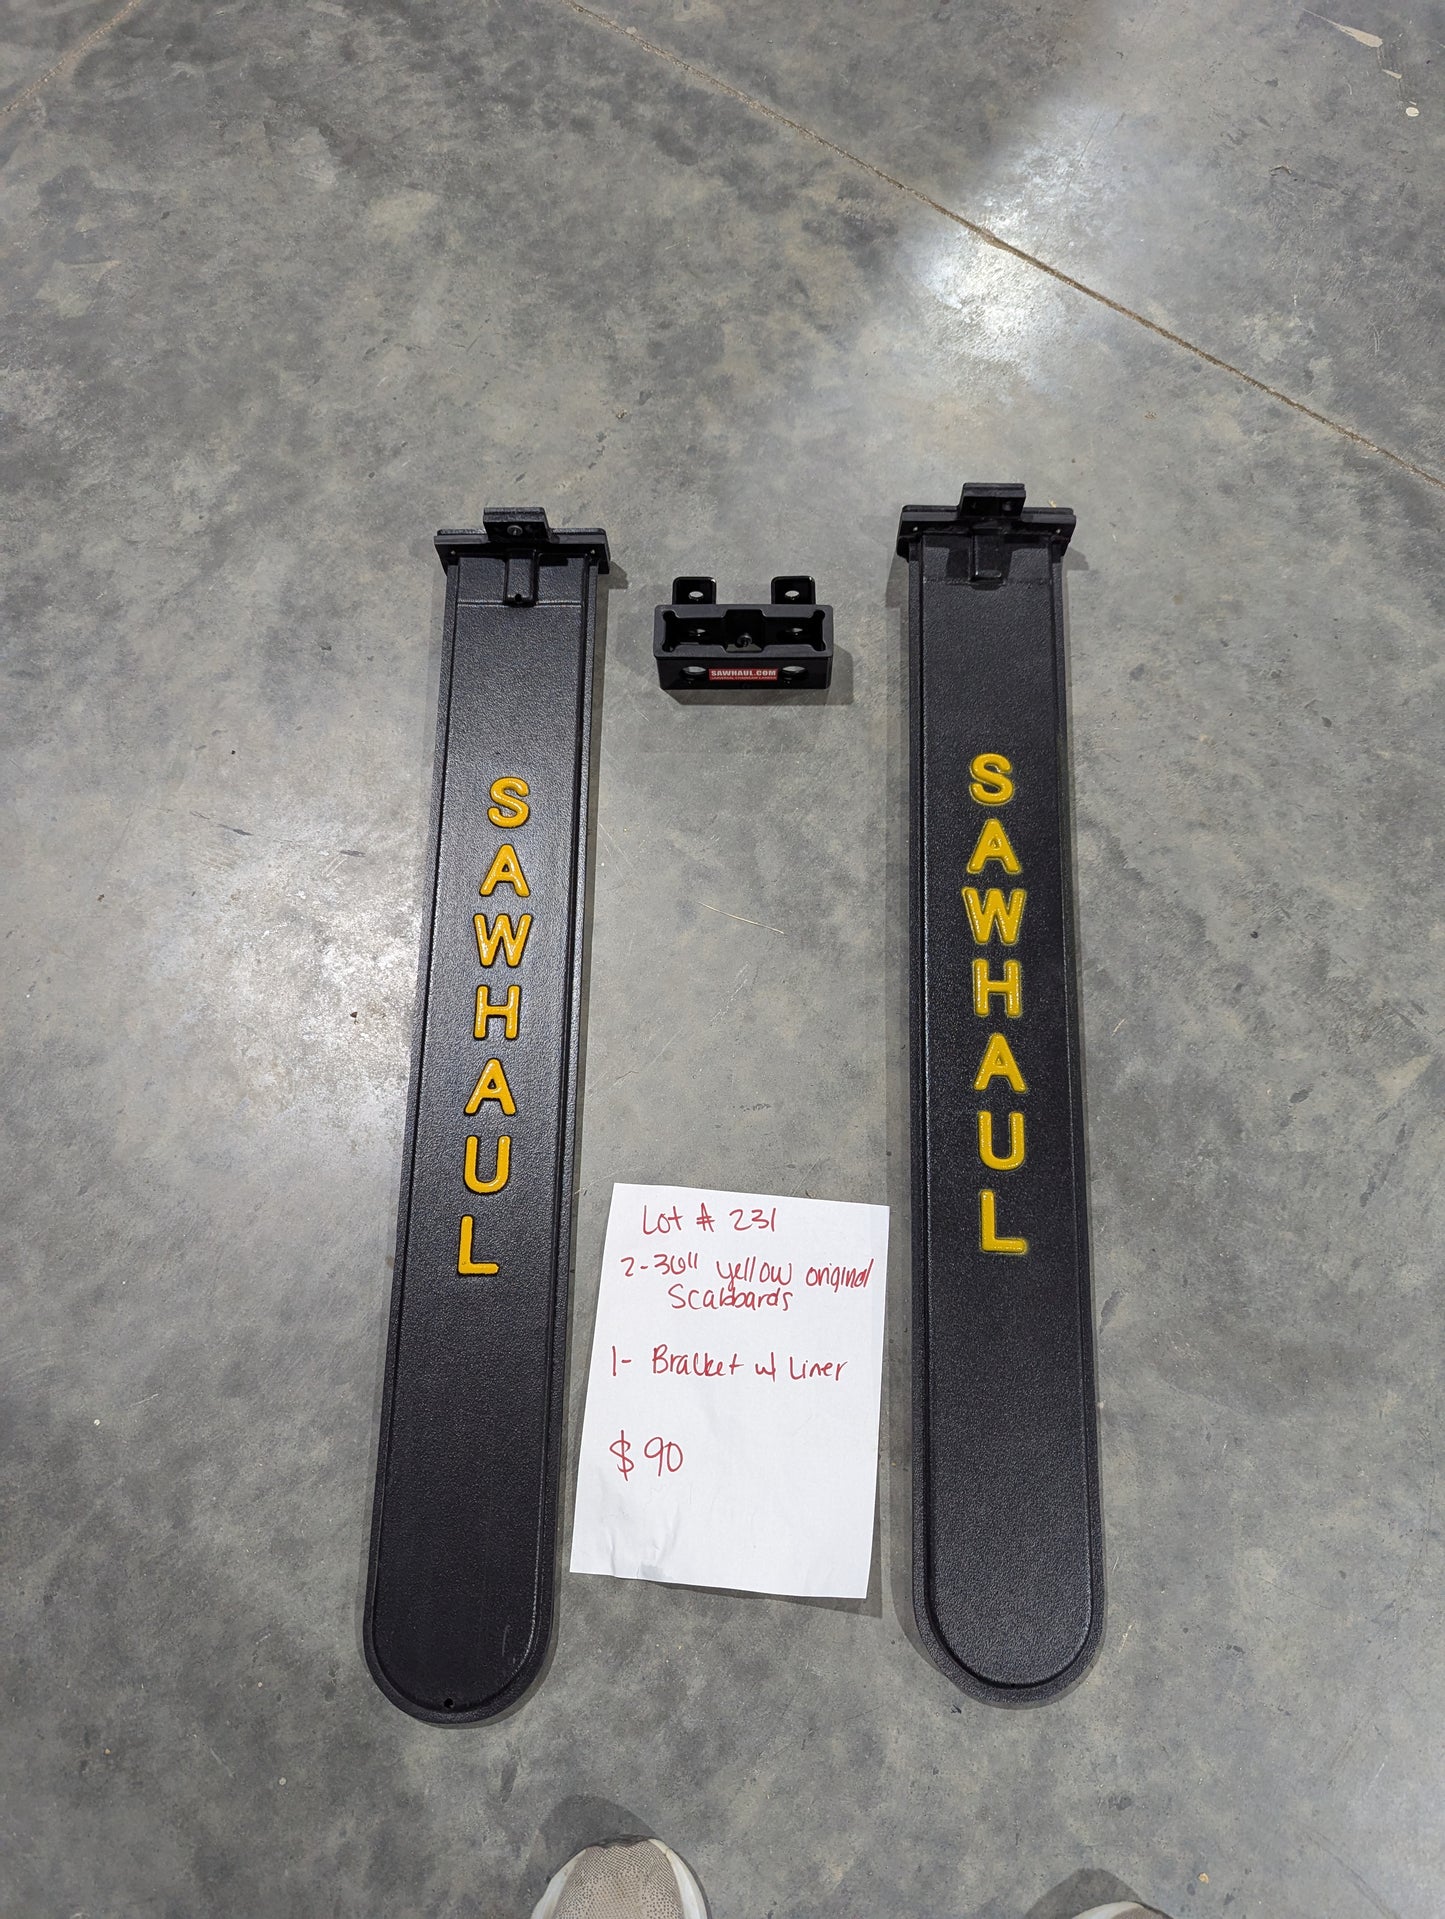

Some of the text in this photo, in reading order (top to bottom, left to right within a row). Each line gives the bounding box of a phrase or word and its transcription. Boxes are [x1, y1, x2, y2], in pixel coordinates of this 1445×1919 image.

[960, 752, 1029, 1255] SAWHAUL
[457, 777, 532, 1276] SAWHAUL
[642, 1202, 777, 1235] Lot # 231
[805, 1258, 875, 1293] original
[652, 1343, 744, 1377] Bracket
[755, 1351, 777, 1382] w/
